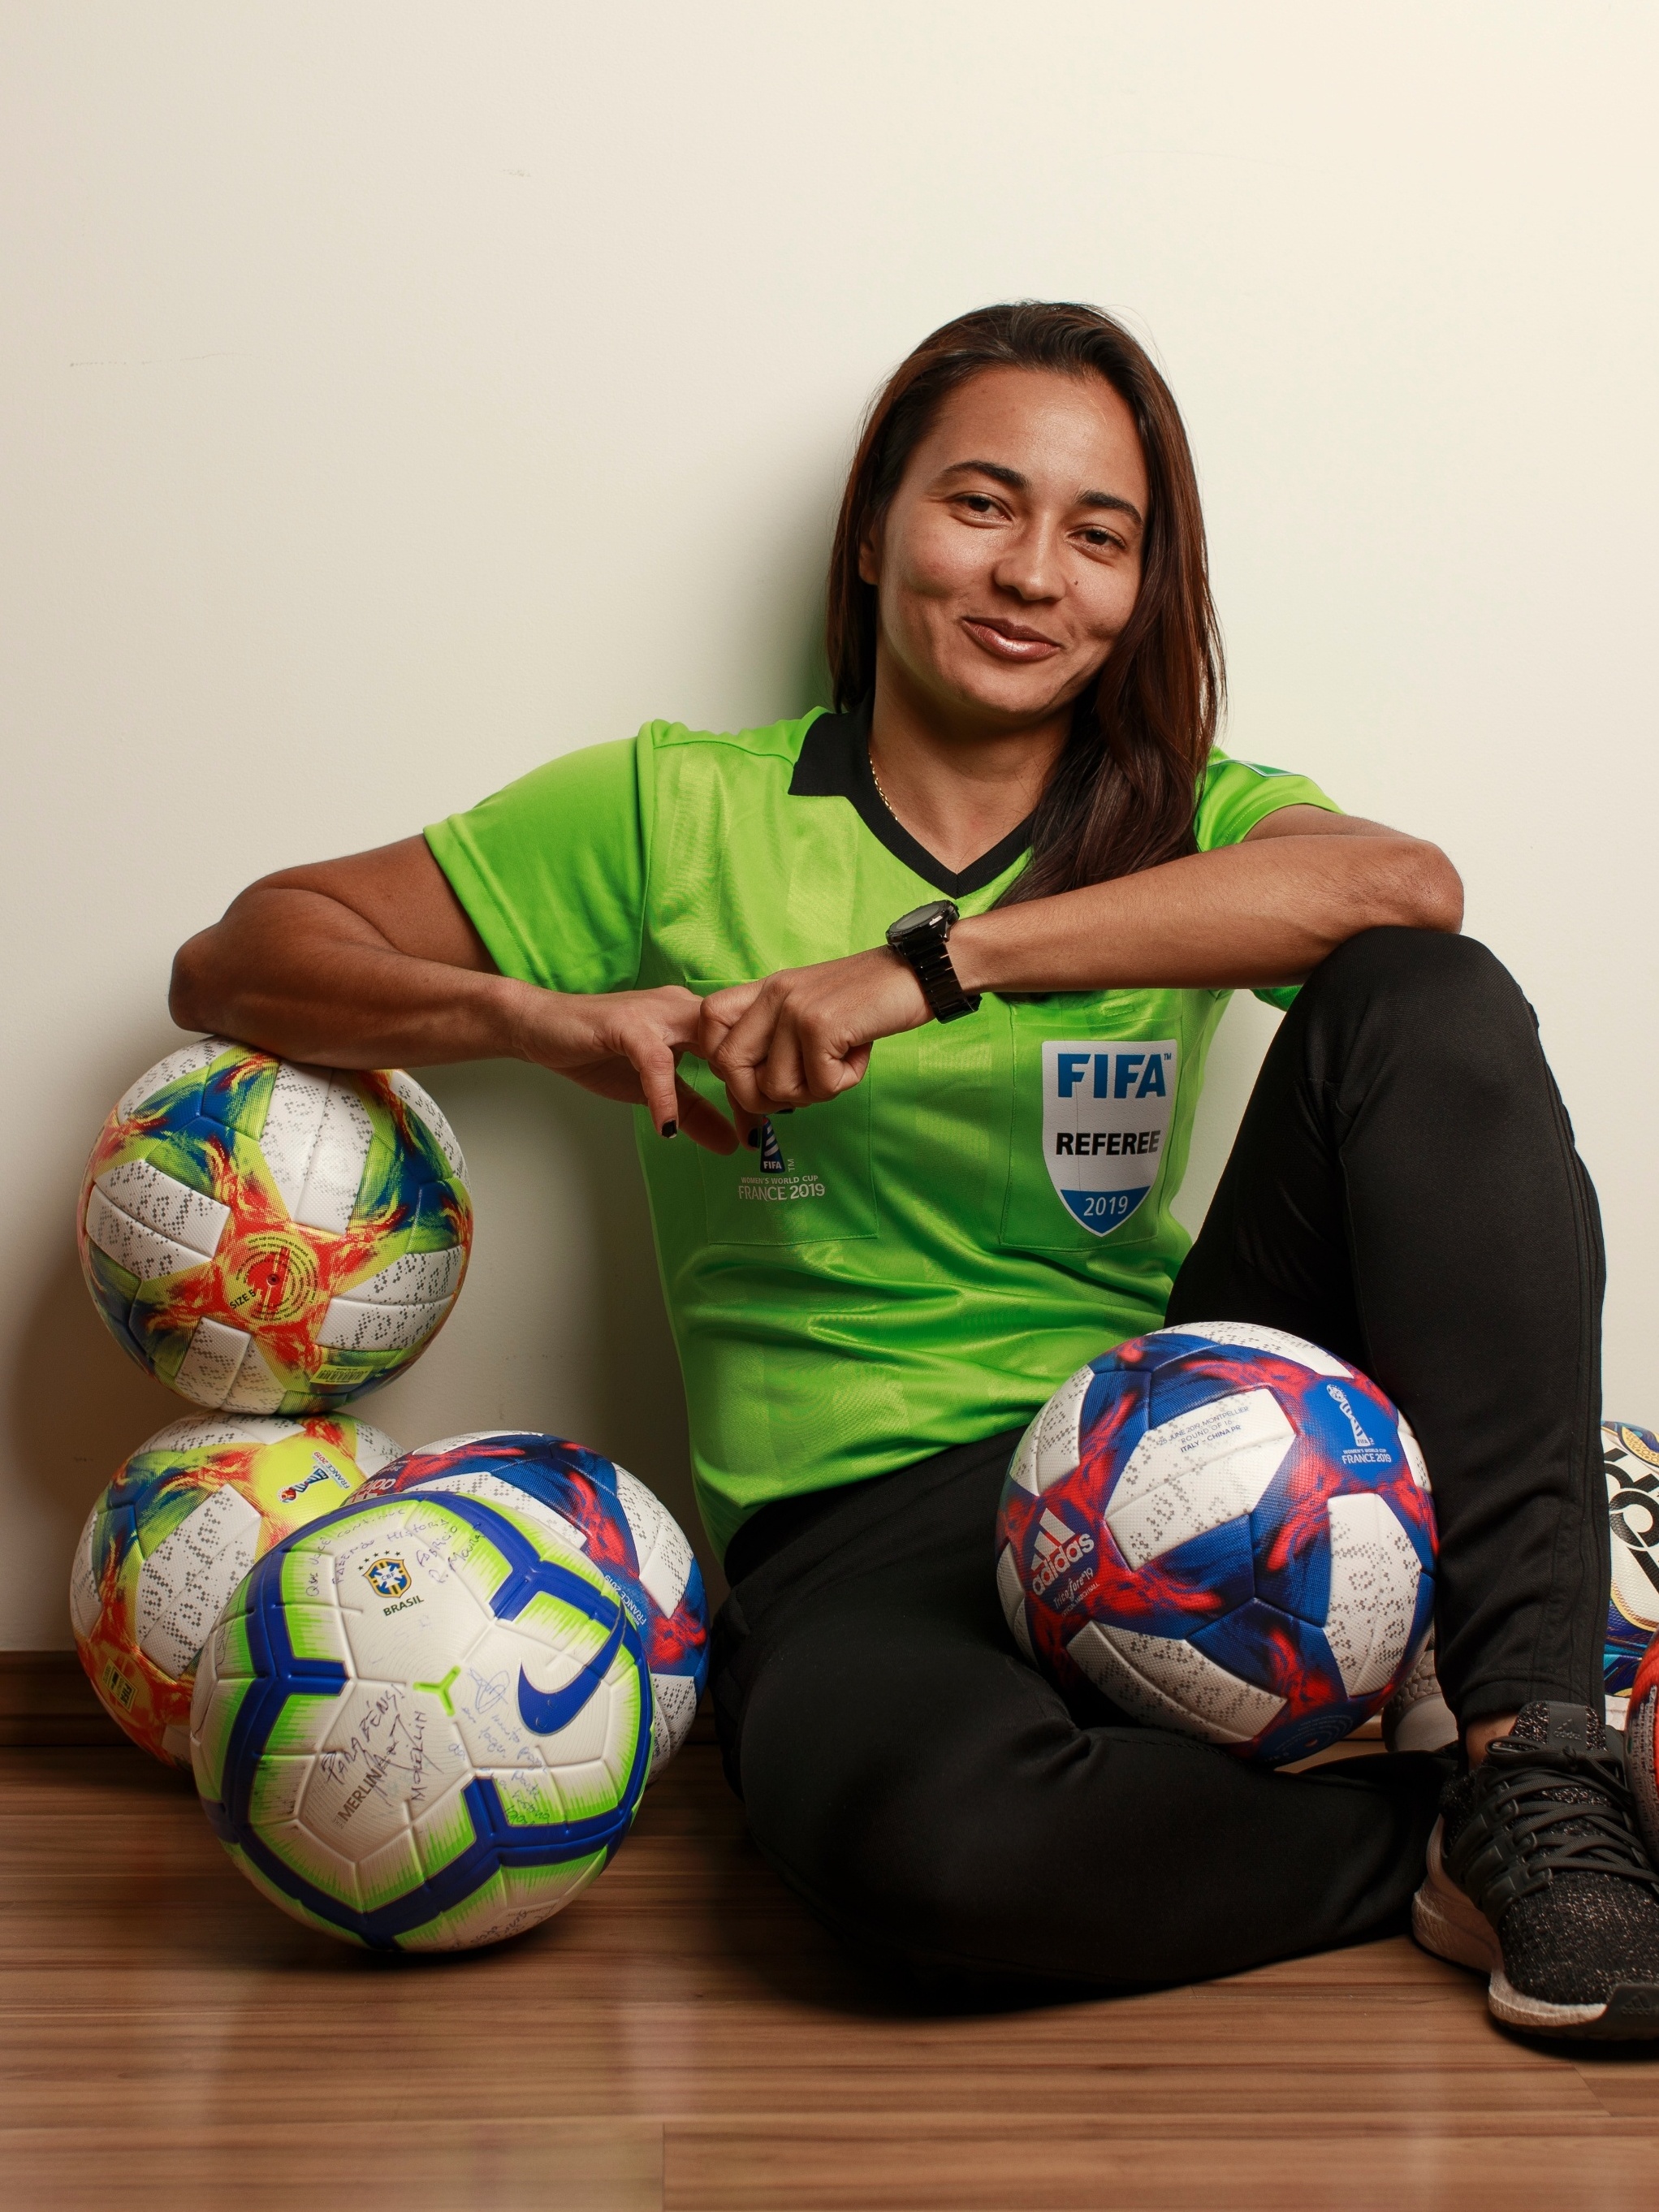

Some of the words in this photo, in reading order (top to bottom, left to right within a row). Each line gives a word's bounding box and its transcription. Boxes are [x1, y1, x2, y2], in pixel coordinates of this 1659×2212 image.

[1057, 1052, 1166, 1099] FIFA
[1056, 1130, 1161, 1156] REFEREE
[763, 1160, 782, 1169] FIFA
[738, 1185, 788, 1201] FRANCE
[789, 1183, 826, 1199] 2019
[741, 1177, 769, 1185] WOMEN'S
[771, 1177, 800, 1185] WORLD
[1083, 1195, 1129, 1216] 2019
[229, 1293, 250, 1309] SIZE
[248, 1289, 256, 1298] 5
[1169, 1429, 1186, 1441] JUNE
[1202, 1406, 1250, 1427] MONTPELLIER
[1181, 1428, 1209, 1444] ROUND
[1211, 1422, 1222, 1431] OF
[1180, 1441, 1200, 1453] ITALY
[1207, 1428, 1230, 1441] CHINA
[1231, 1424, 1242, 1432] PR
[313, 1451, 329, 1465] 2019
[1341, 1453, 1376, 1465] FRANCE
[1376, 1453, 1392, 1463] 2019
[327, 1463, 349, 1489] FRANCE
[1032, 1533, 1095, 1596] adidas
[381, 1571, 395, 1582] CBF
[604, 1575, 621, 1592] 2019
[382, 1595, 425, 1617] BRASIL
[620, 1592, 647, 1626] FRANCE
[338, 1768, 382, 1822] MERLIN
